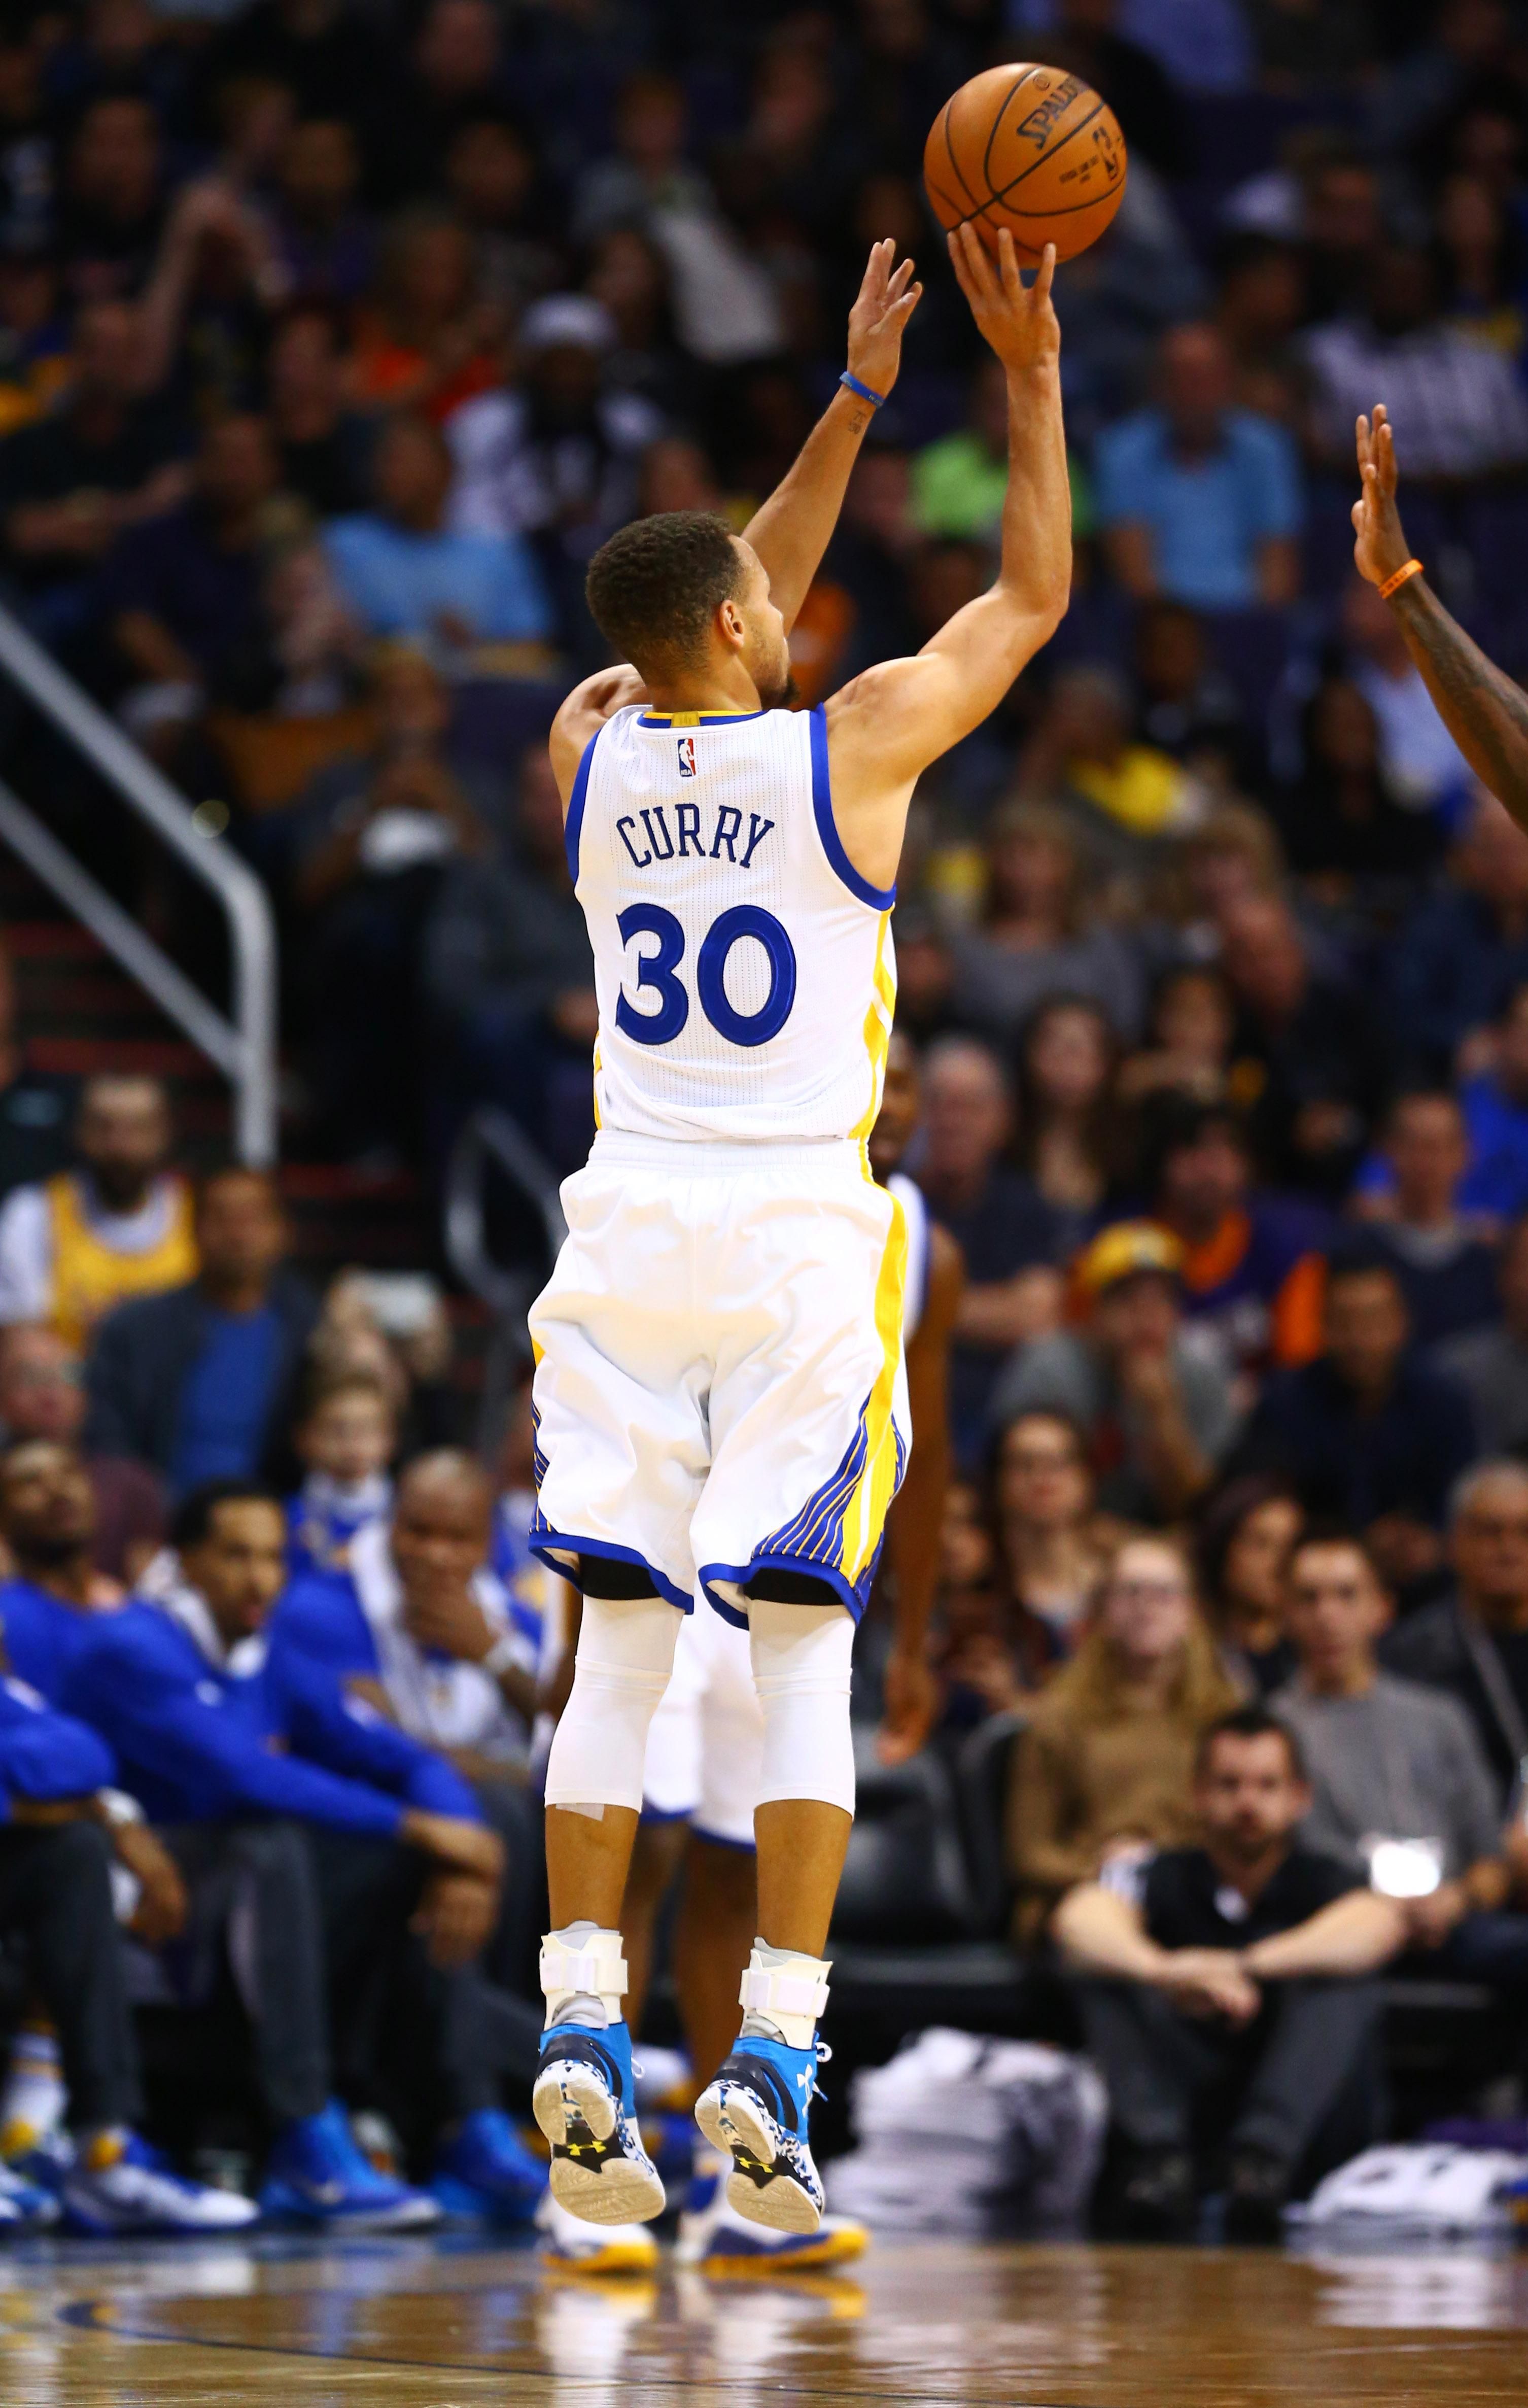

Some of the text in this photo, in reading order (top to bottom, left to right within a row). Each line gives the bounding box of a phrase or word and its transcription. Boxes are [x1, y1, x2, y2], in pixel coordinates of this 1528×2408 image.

[1017, 76, 1086, 150] SPALD
[616, 803, 775, 869] CURRY
[615, 903, 796, 1047] 30
